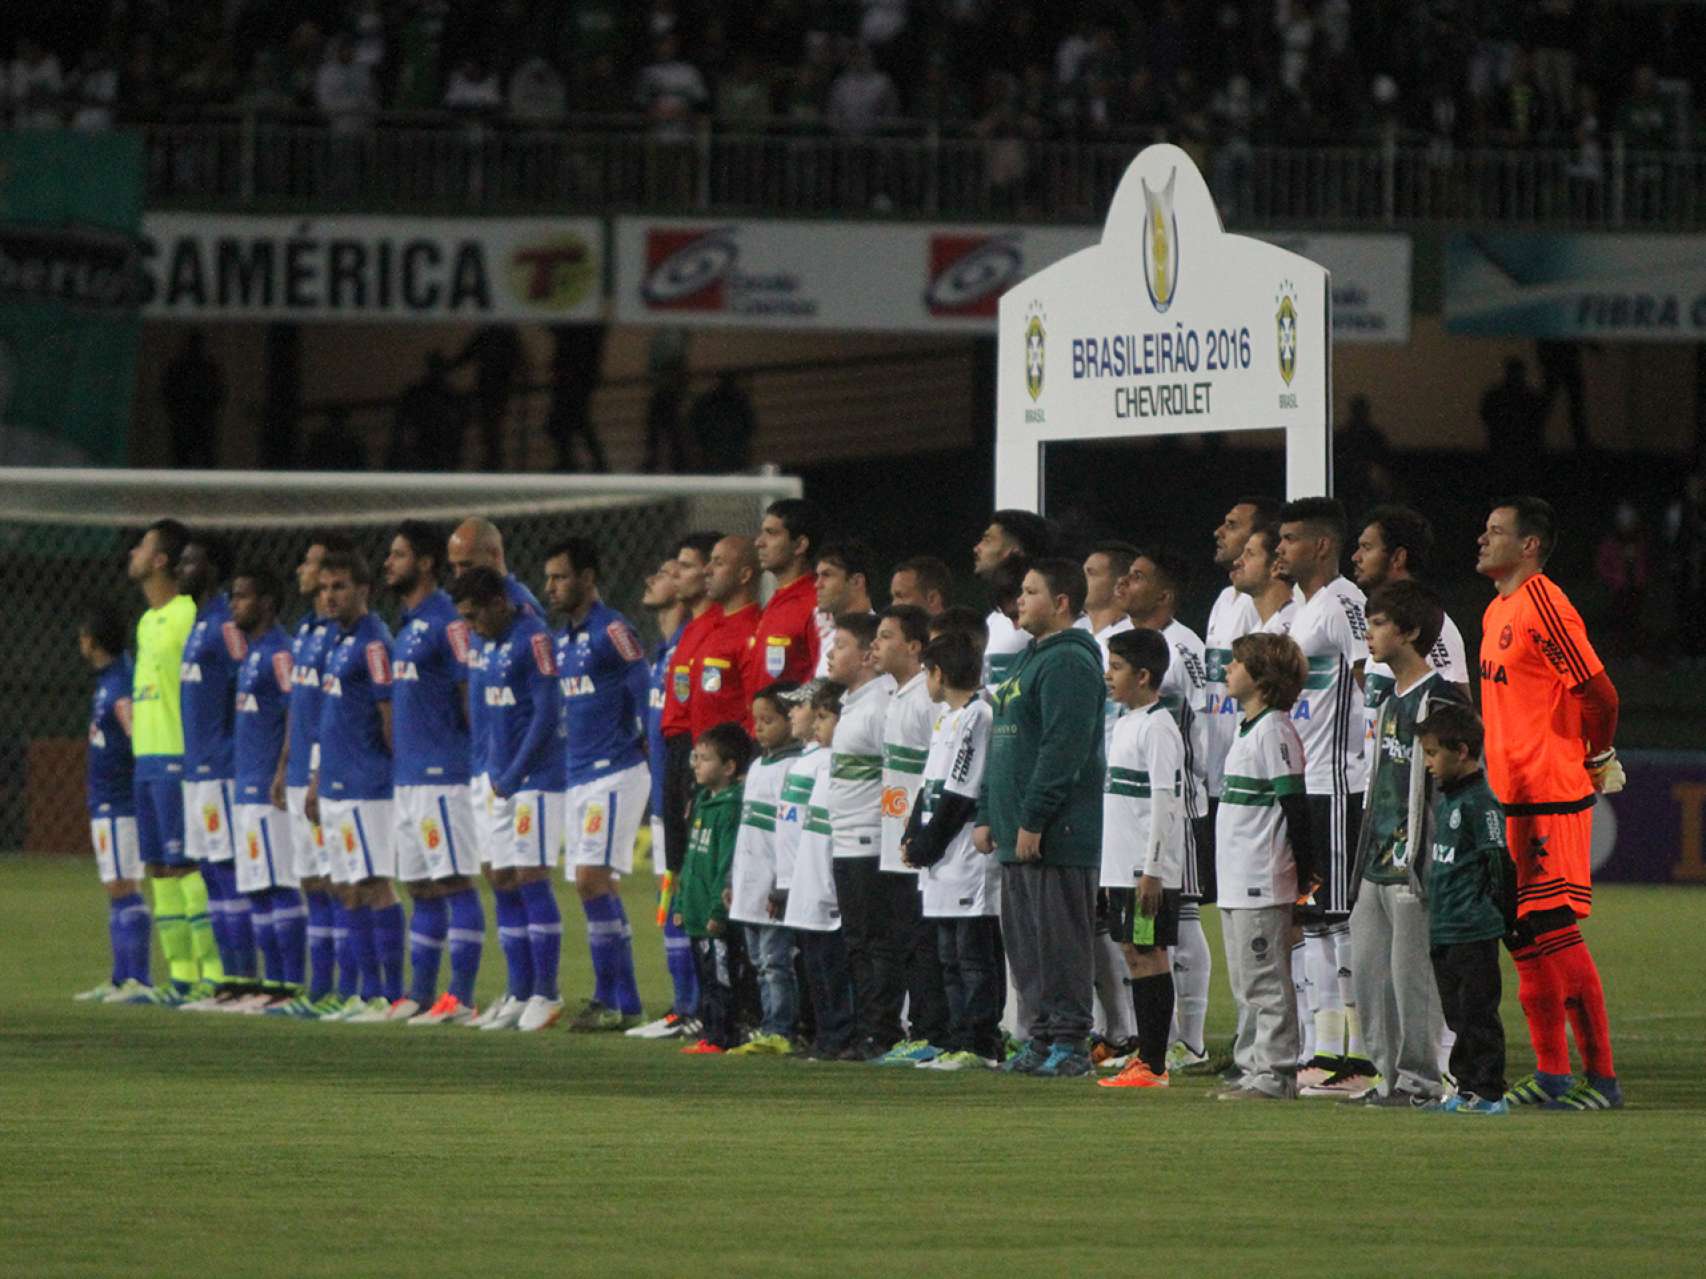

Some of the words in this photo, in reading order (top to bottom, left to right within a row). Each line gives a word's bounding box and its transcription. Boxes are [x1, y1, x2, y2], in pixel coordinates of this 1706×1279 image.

[1072, 321, 1200, 379] BRASILEIRÃO
[1206, 327, 1252, 372] 2016
[1025, 409, 1045, 423] BRASIL
[1115, 382, 1213, 418] CHEVROLET
